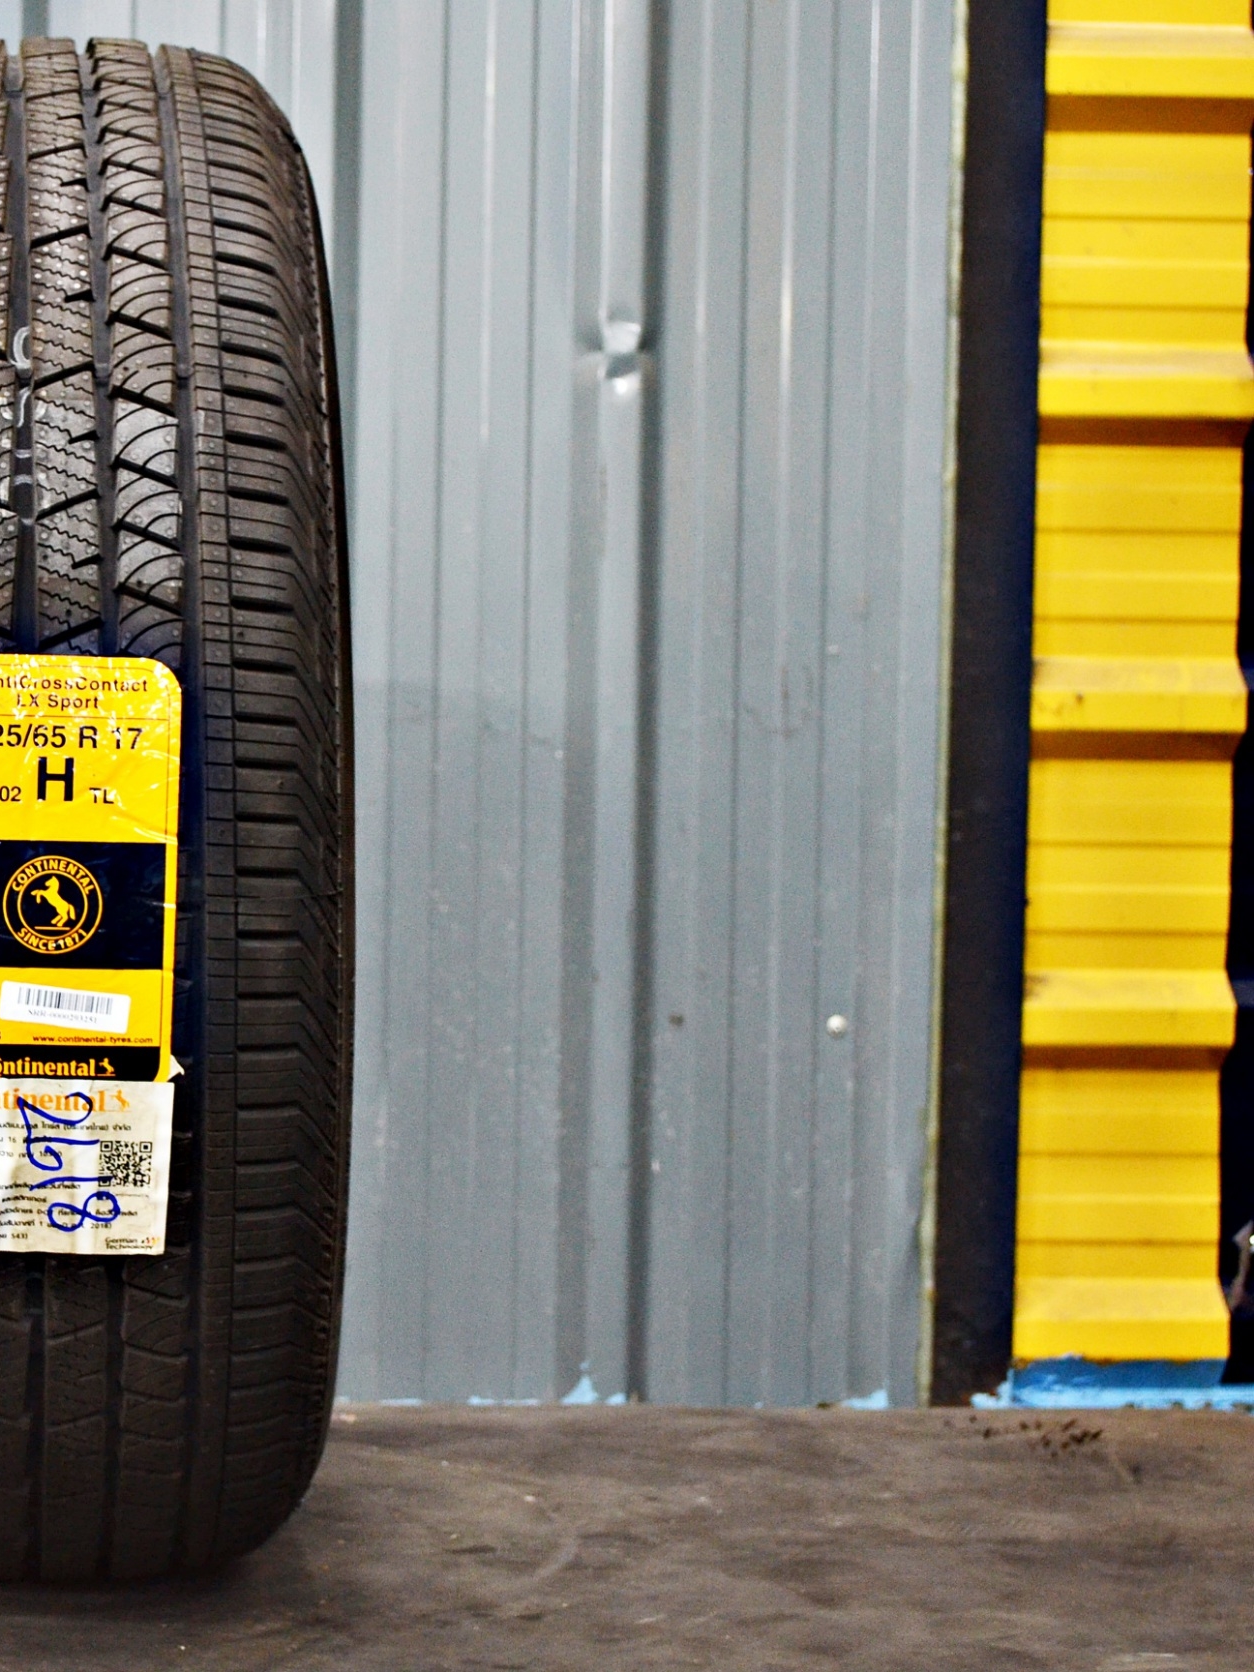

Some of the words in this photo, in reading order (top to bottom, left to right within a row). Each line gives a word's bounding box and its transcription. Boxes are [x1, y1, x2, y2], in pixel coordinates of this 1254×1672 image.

[16, 693, 40, 707] LX
[47, 694, 99, 711] Sport
[79, 726, 98, 749] R
[112, 727, 143, 750] 17
[37, 757, 75, 802] H
[89, 787, 115, 804] TL
[11, 858, 97, 895] CONTINENTAL
[17, 927, 56, 951] SINCE
[58, 927, 88, 950] 1871
[32, 1034, 154, 1045] www.continental-tyres.com
